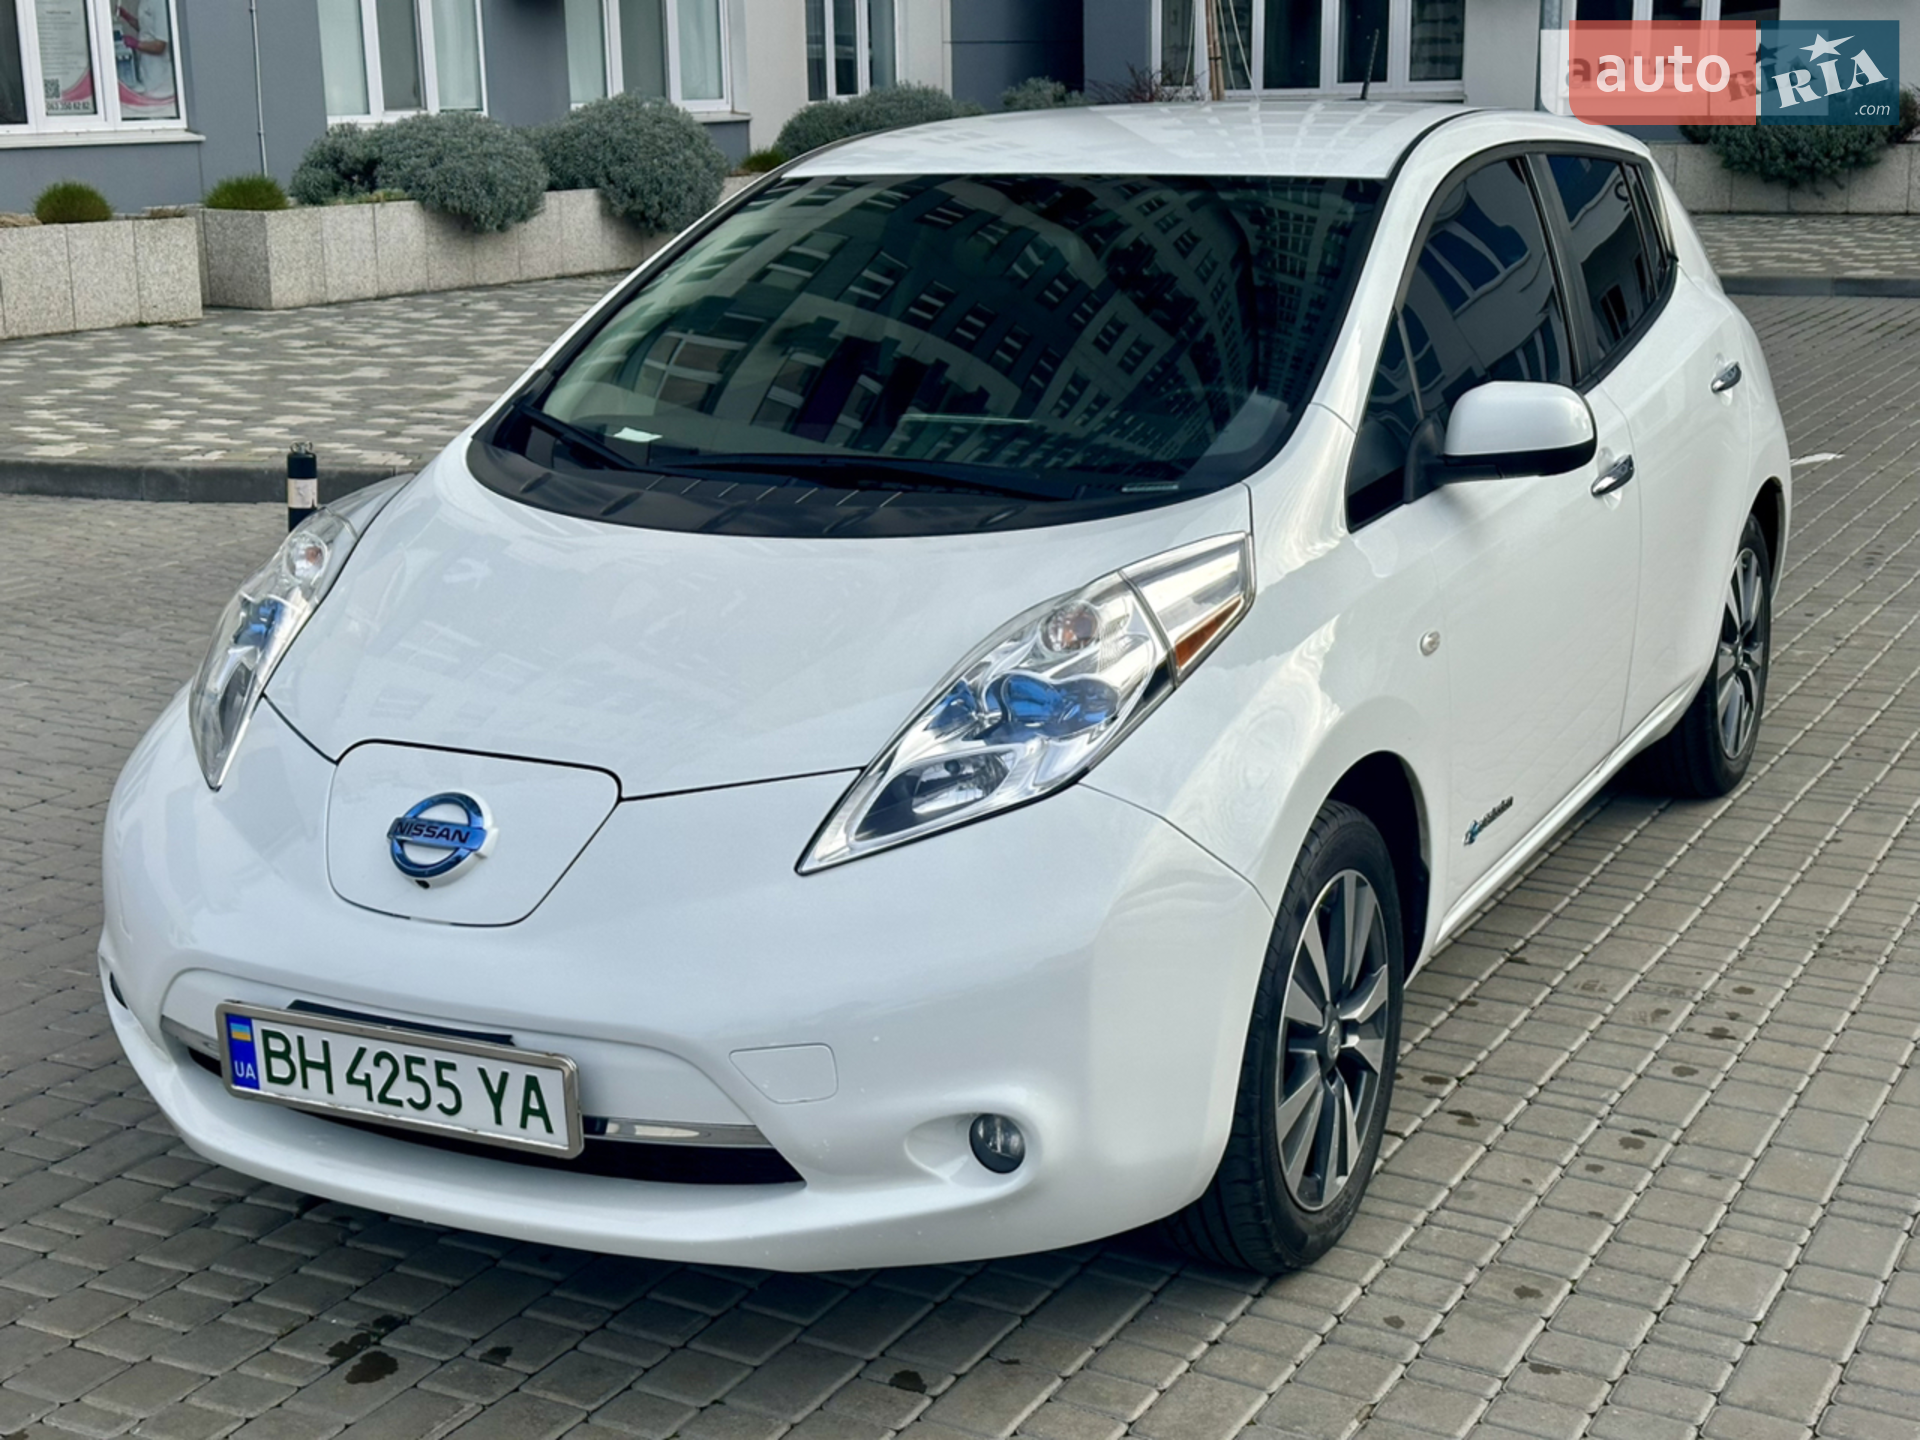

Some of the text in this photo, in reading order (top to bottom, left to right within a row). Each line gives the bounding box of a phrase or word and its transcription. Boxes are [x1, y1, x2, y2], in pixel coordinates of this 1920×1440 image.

[394, 821, 471, 844] NISSAN
[233, 1060, 257, 1081] UA
[260, 1028, 555, 1135] BH 4255 YA
